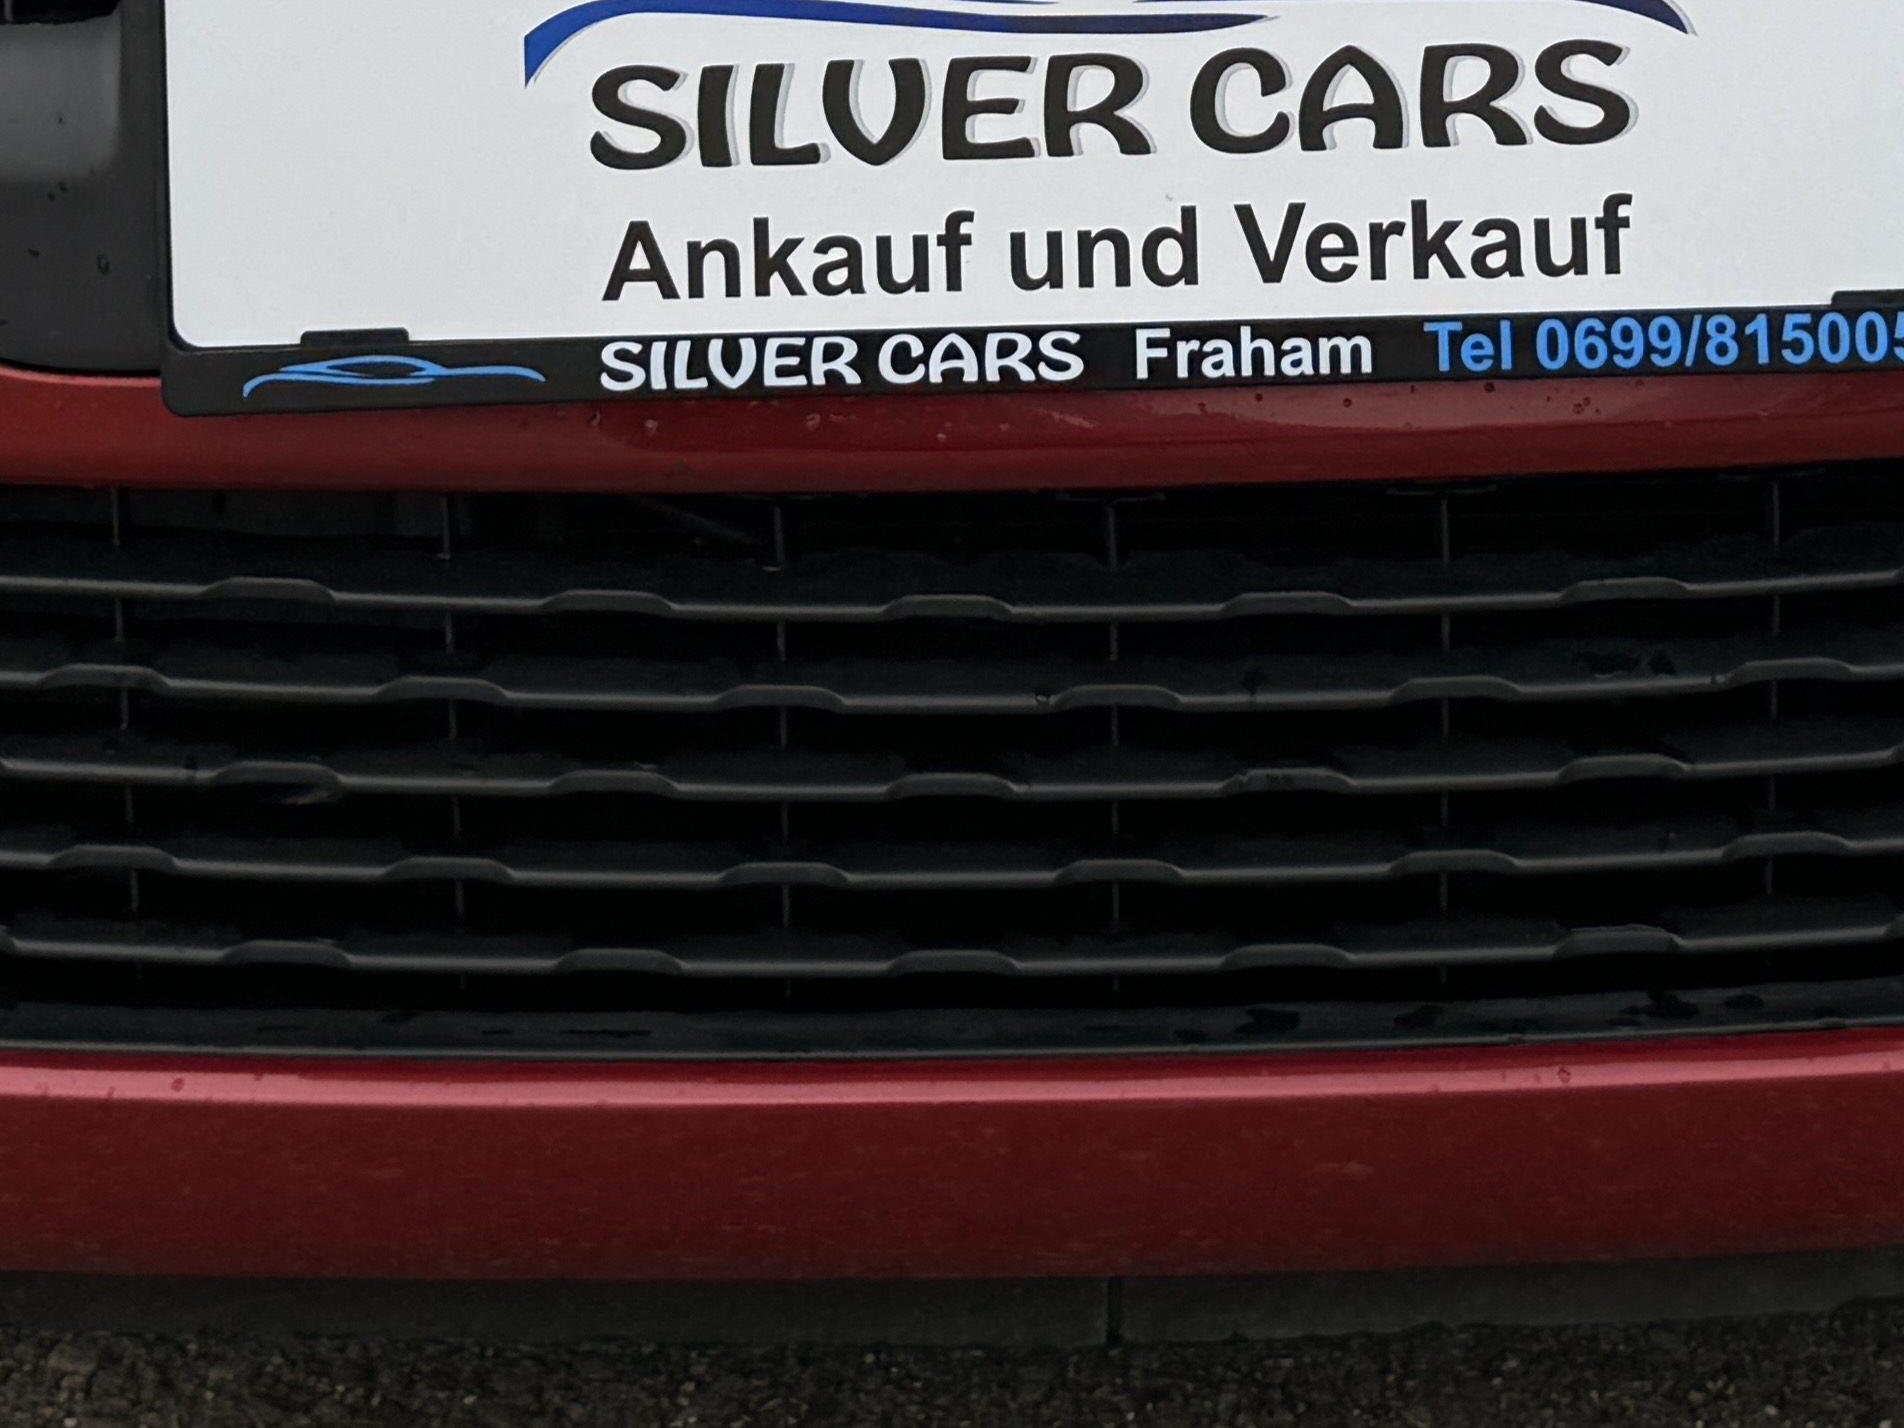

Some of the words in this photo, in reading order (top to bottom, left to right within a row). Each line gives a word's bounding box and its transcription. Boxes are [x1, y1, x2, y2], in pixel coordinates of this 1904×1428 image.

[590, 46, 1152, 172] SILVER
[1189, 38, 1631, 154] CARS
[602, 210, 976, 302] Ankauf
[1008, 205, 1200, 291] und
[1234, 193, 1634, 285] Verkauf
[598, 331, 864, 393] SILVER
[876, 329, 1086, 387] CARS
[1134, 326, 1374, 381] Fraham
[1422, 320, 1514, 374] Tel
